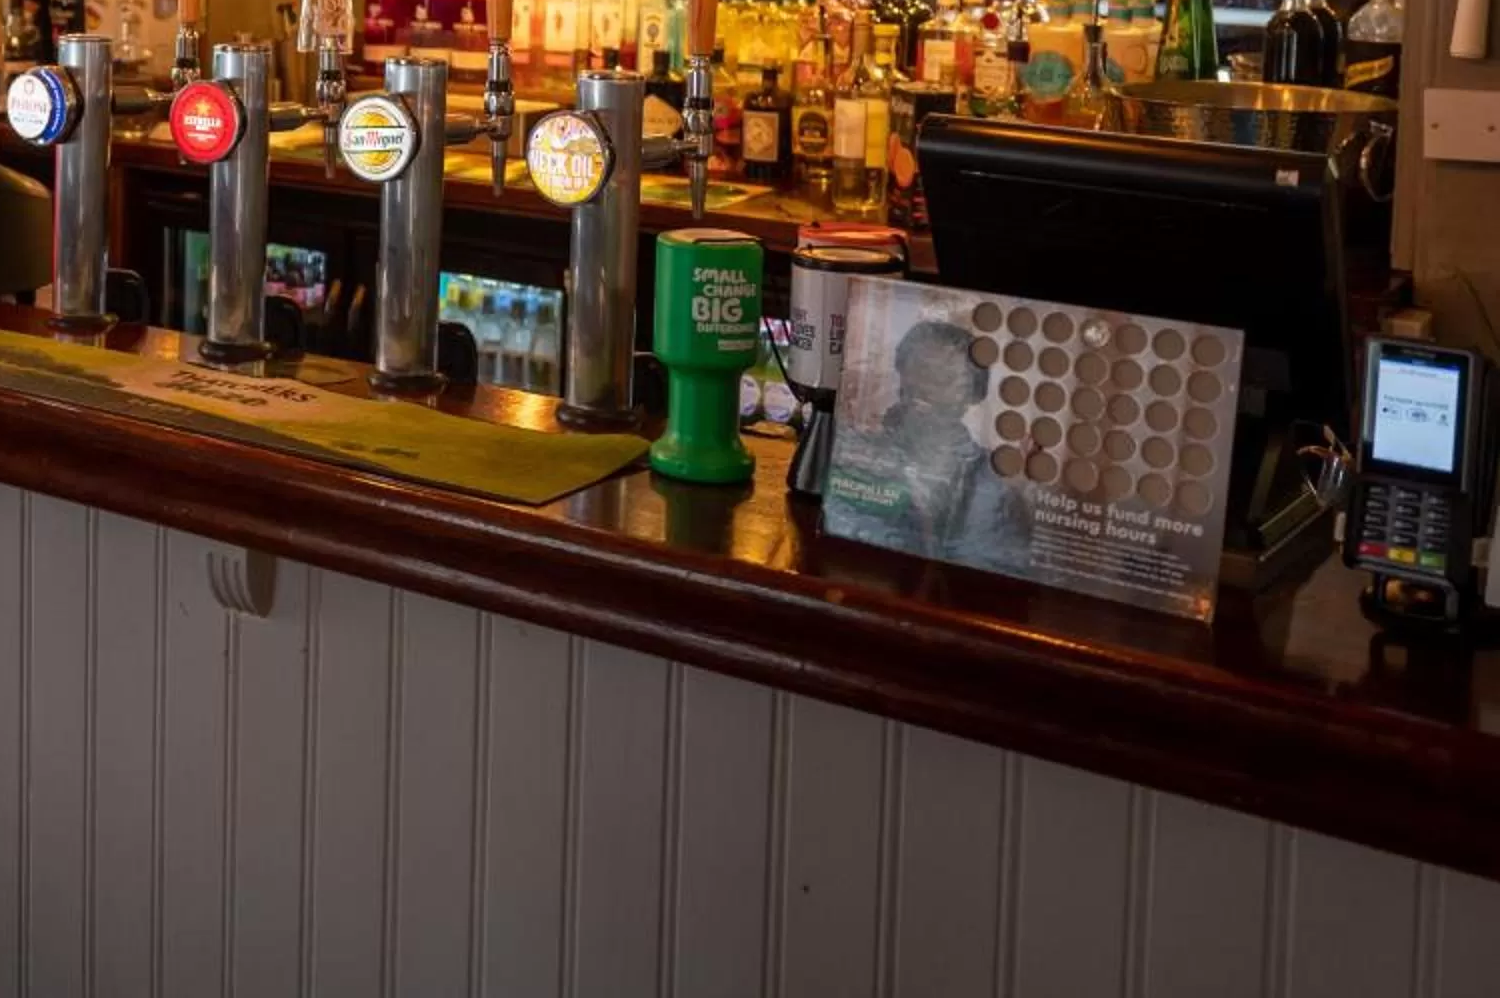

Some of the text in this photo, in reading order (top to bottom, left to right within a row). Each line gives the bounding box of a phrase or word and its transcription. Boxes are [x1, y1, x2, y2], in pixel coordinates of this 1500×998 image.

[528, 148, 597, 178] NECK OIL
[692, 267, 747, 283] SMALL
[691, 296, 743, 323] BIG
[1035, 508, 1157, 546] nursing hours
[1037, 489, 1205, 538] Help us fund more
